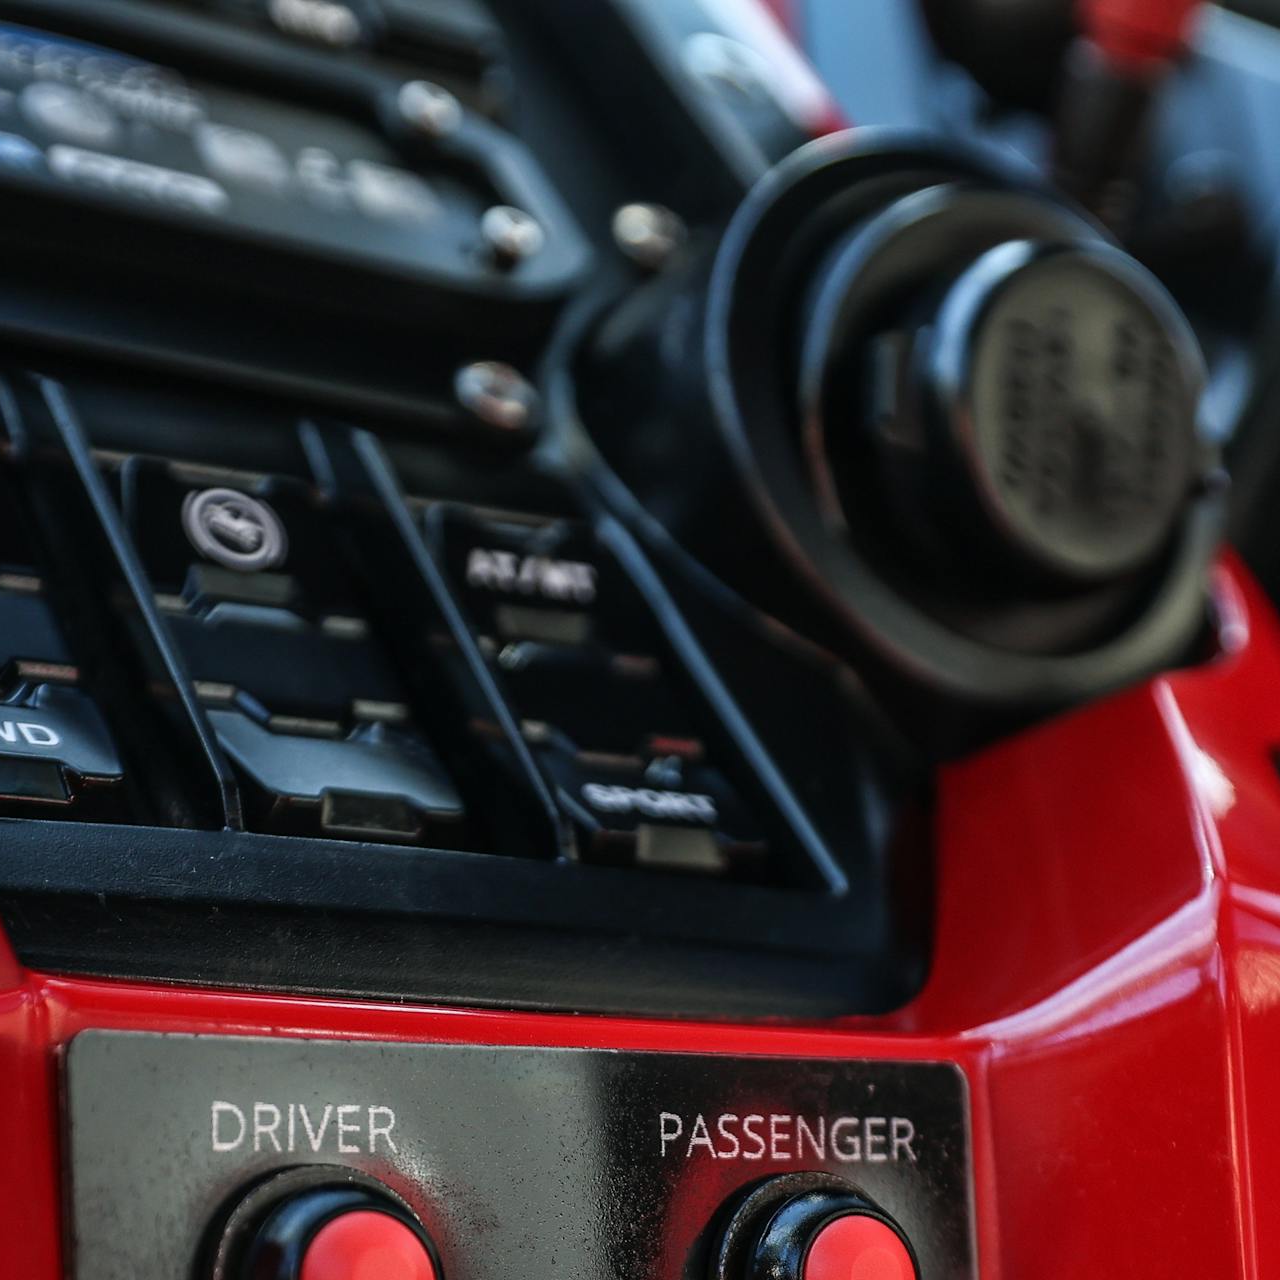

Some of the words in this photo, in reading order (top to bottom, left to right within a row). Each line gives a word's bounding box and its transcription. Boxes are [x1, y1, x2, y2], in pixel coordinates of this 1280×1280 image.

[581, 783, 717, 822] SPORT
[210, 1100, 397, 1156] DRIVER
[658, 1111, 918, 1163] PASSENGER
